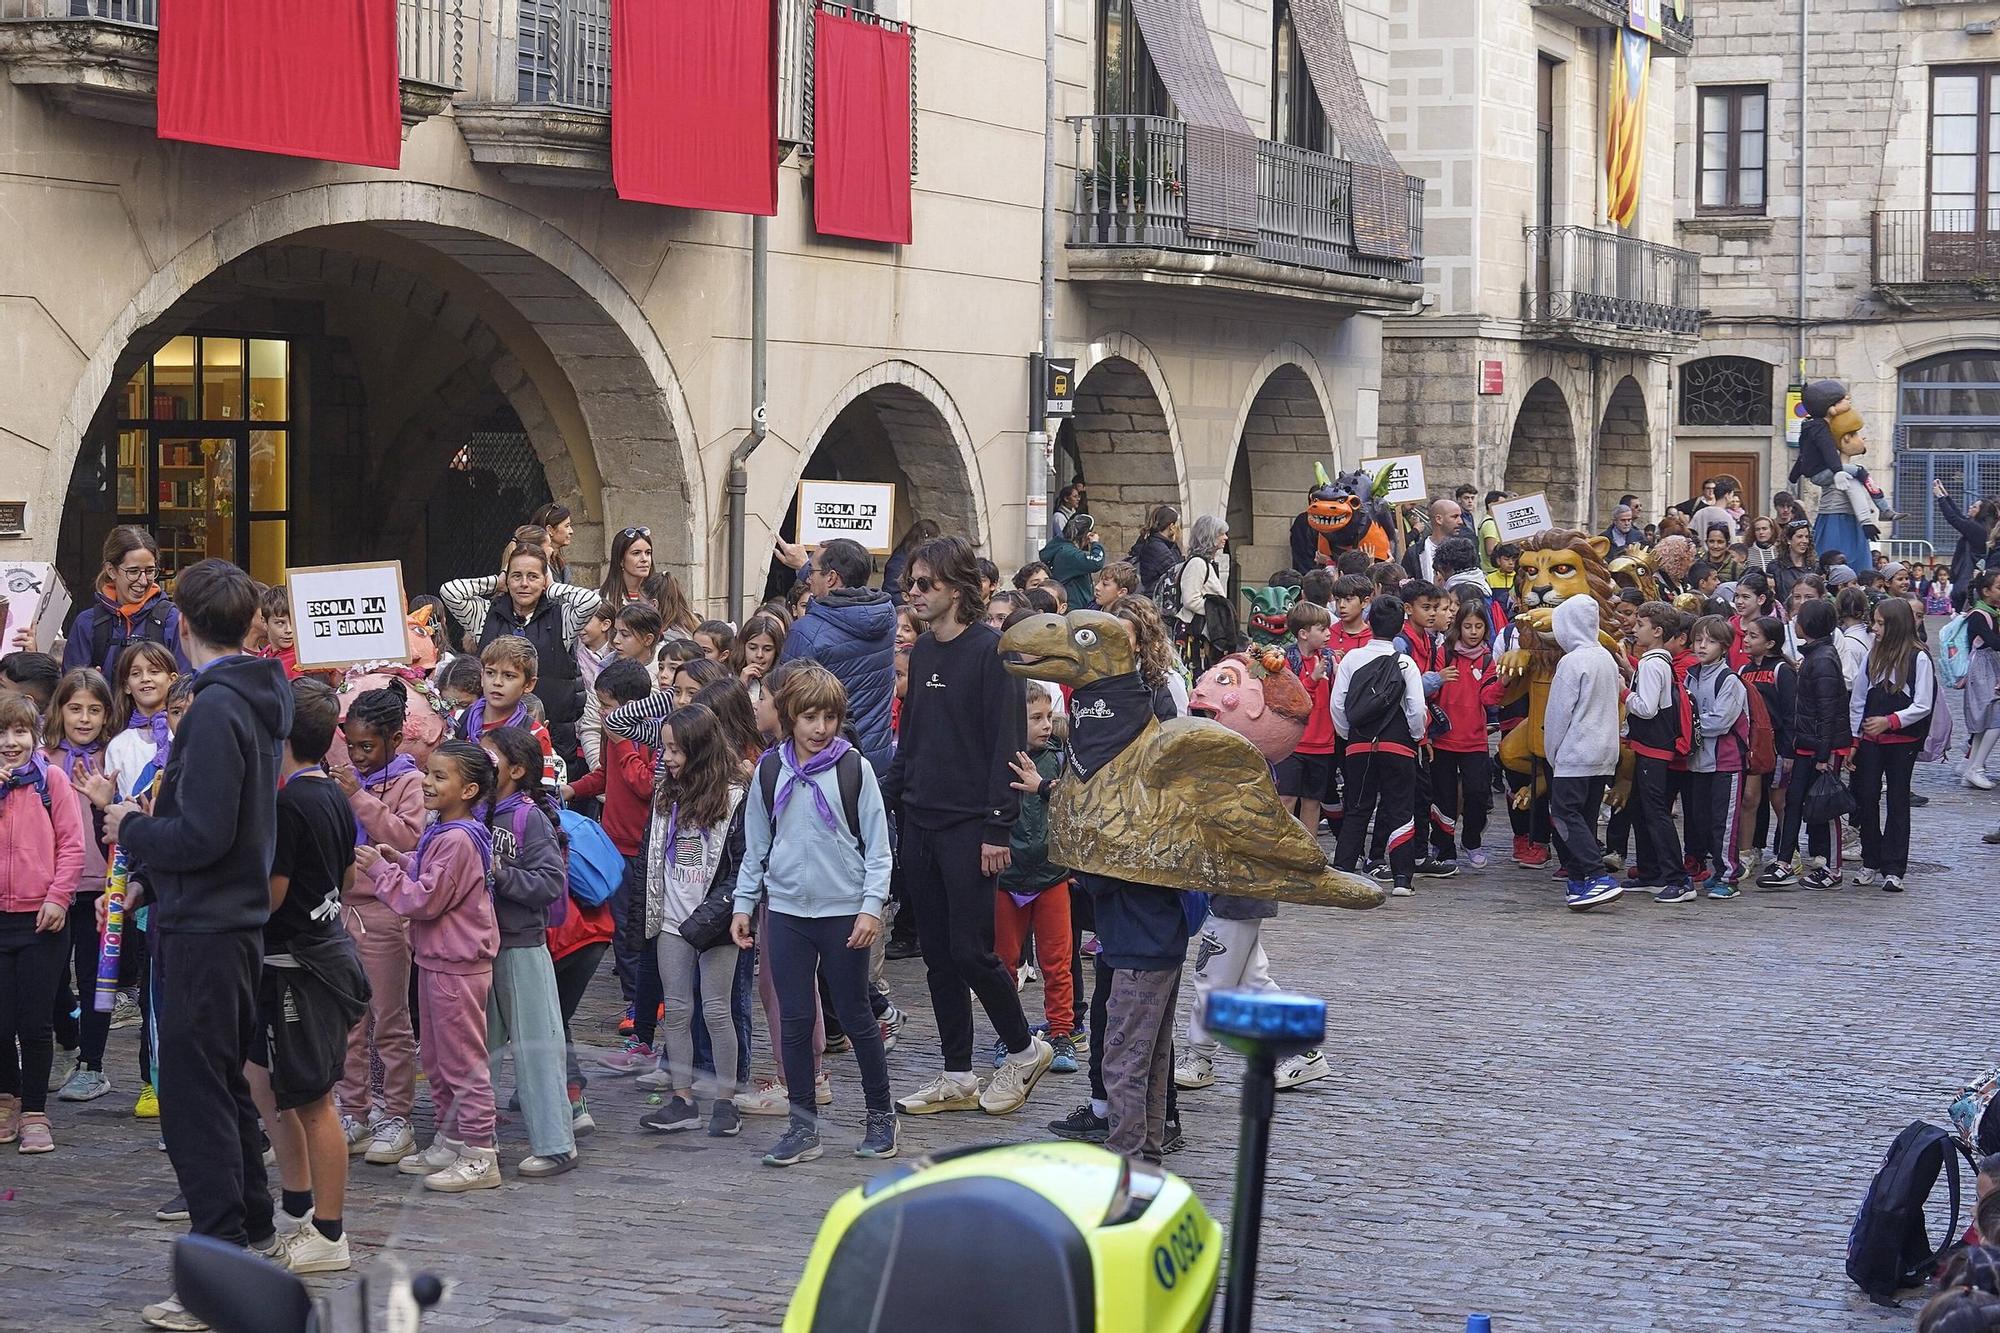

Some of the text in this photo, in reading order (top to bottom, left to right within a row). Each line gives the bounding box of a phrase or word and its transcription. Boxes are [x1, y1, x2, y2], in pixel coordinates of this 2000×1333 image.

[1056, 401, 1064, 411] 12
[813, 503, 877, 516] ESCOLA DR.
[1507, 507, 1534, 520] ESCOLA
[817, 517, 873, 530] MASMITJA
[307, 597, 386, 617] ESCOLA PLA
[314, 618, 384, 637] DE GIRONA
[103, 892, 127, 958] CANNON
